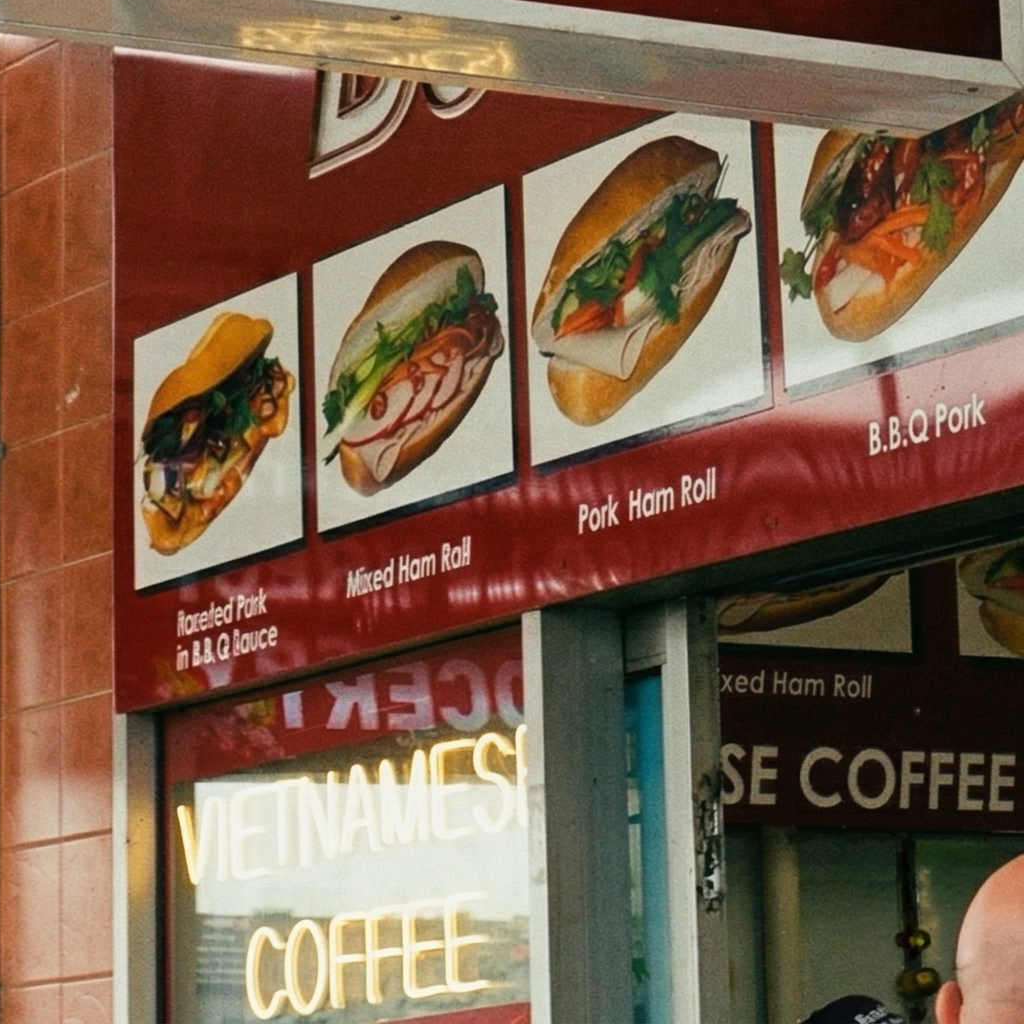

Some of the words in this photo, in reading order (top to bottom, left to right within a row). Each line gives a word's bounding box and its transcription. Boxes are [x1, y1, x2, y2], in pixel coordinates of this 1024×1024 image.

[935, 390, 986, 438] Pork
[578, 493, 619, 535] Pork
[628, 485, 675, 522] Ham
[681, 466, 717, 508] Roll
[398, 553, 437, 584] Ham
[772, 670, 825, 697] Ham
[833, 673, 874, 699] Roll
[799, 746, 1017, 812] COFFEE
[245, 891, 489, 1020] COFFEE
